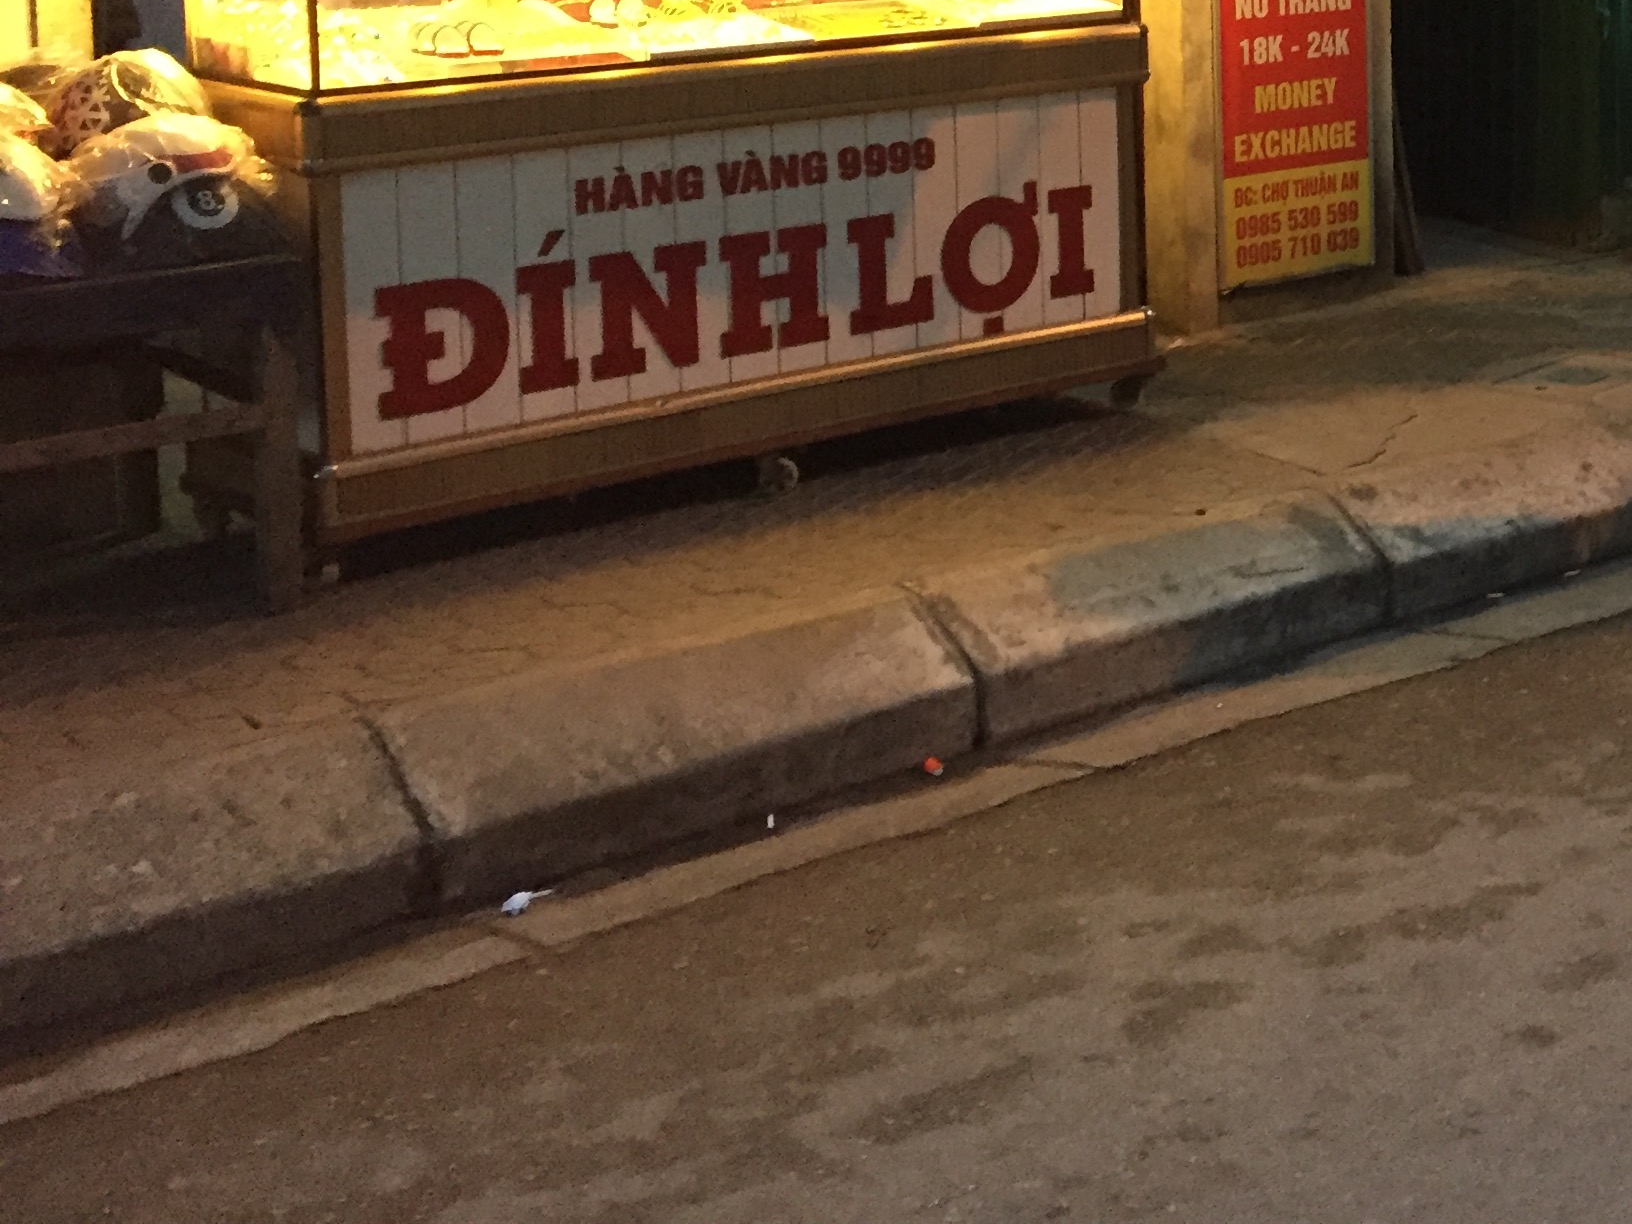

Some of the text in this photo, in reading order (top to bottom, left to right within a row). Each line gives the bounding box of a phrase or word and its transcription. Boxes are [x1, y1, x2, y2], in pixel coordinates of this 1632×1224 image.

[1239, 34, 1284, 66] 18K
[1307, 28, 1351, 60] 24K
[1254, 77, 1338, 114] MONEY
[1234, 120, 1357, 163] EXCHANGE
[575, 137, 936, 216] HÀNG VÀNG 9999
[1293, 171, 1337, 199] THUẬN
[1341, 171, 1359, 192] AN
[1287, 205, 1321, 231] 530
[1287, 233, 1322, 259] 710
[374, 180, 1096, 422] ĐÍNH LỢI
